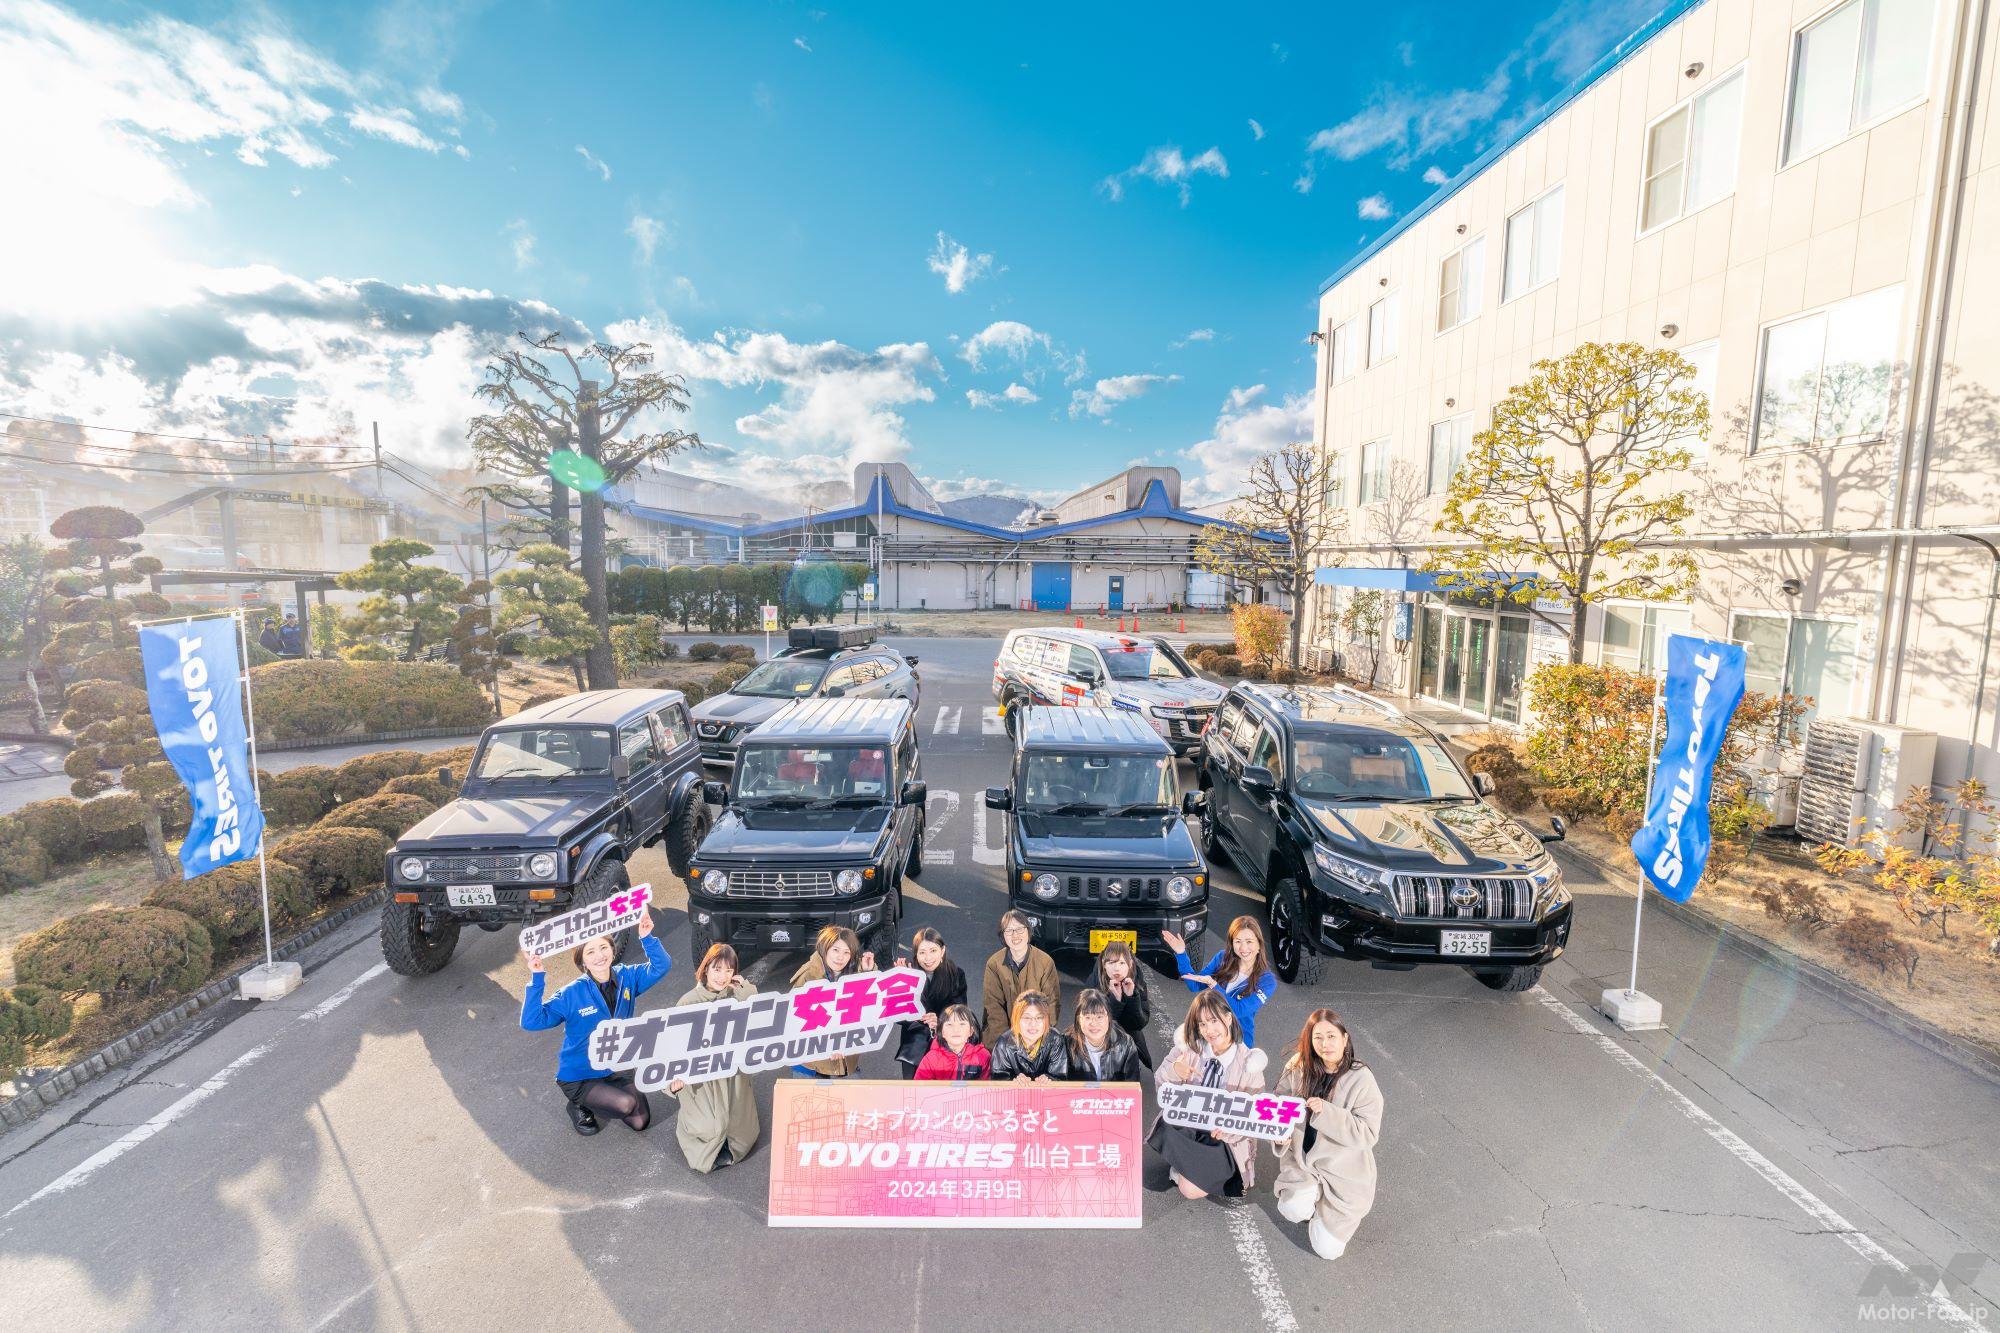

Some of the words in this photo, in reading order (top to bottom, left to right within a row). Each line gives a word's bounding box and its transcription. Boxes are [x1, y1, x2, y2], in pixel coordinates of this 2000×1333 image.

[459, 894, 494, 905] 64-92
[534, 935, 574, 956] OPEN
[578, 911, 642, 940] COUNTRY
[1451, 940, 1488, 954] 92-55
[642, 1050, 735, 1085] OPEN
[744, 1023, 887, 1067] COUNTRY
[845, 1107, 1060, 1133] #オプカンのふるさと
[1167, 1109, 1210, 1125] OPEN
[1214, 1117, 1289, 1137] COUNTRY
[797, 1141, 905, 1169] TOYO
[905, 1141, 1017, 1168] TIRES
[1022, 1143, 1122, 1168] 仙台工場
[887, 1179, 1023, 1200] 2024年3月9日
